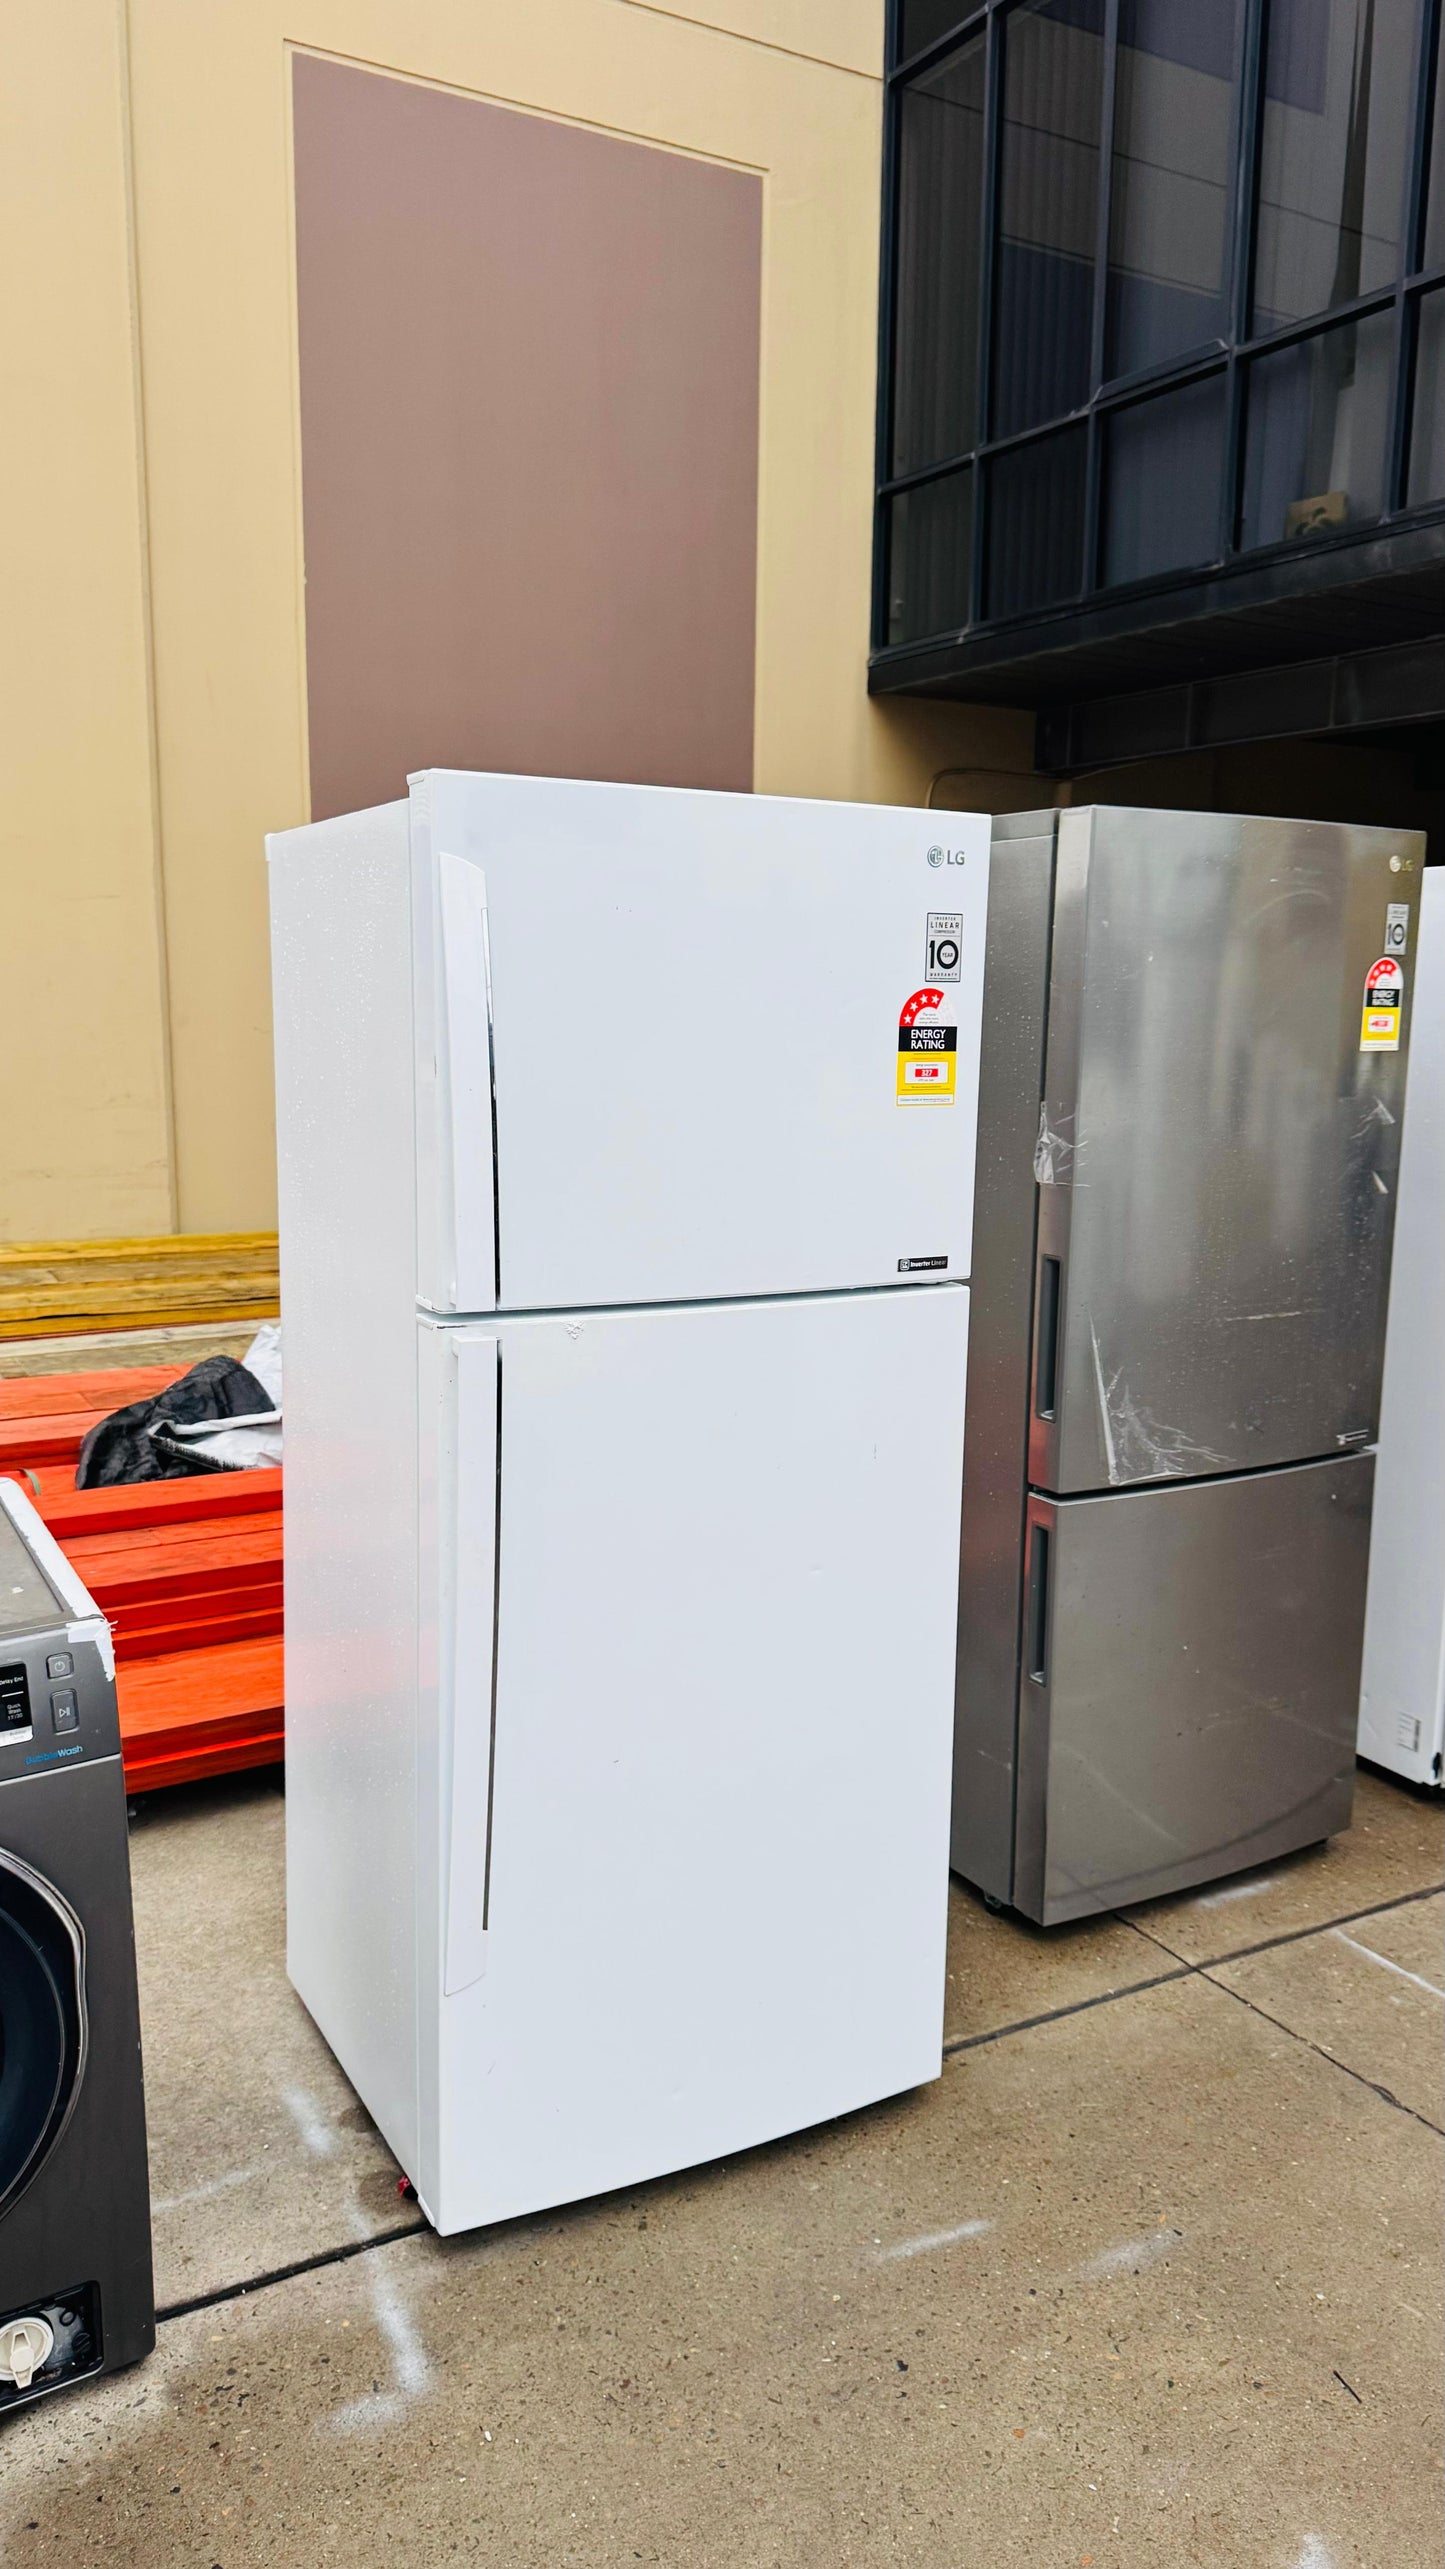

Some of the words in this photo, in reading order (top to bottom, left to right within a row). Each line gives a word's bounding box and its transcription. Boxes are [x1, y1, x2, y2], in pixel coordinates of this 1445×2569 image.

[947, 849, 965, 866] LG
[930, 921, 960, 929] LINEAR
[929, 939, 959, 970] 10
[910, 1029, 946, 1039] ENERGY
[910, 1040, 945, 1050] RATING
